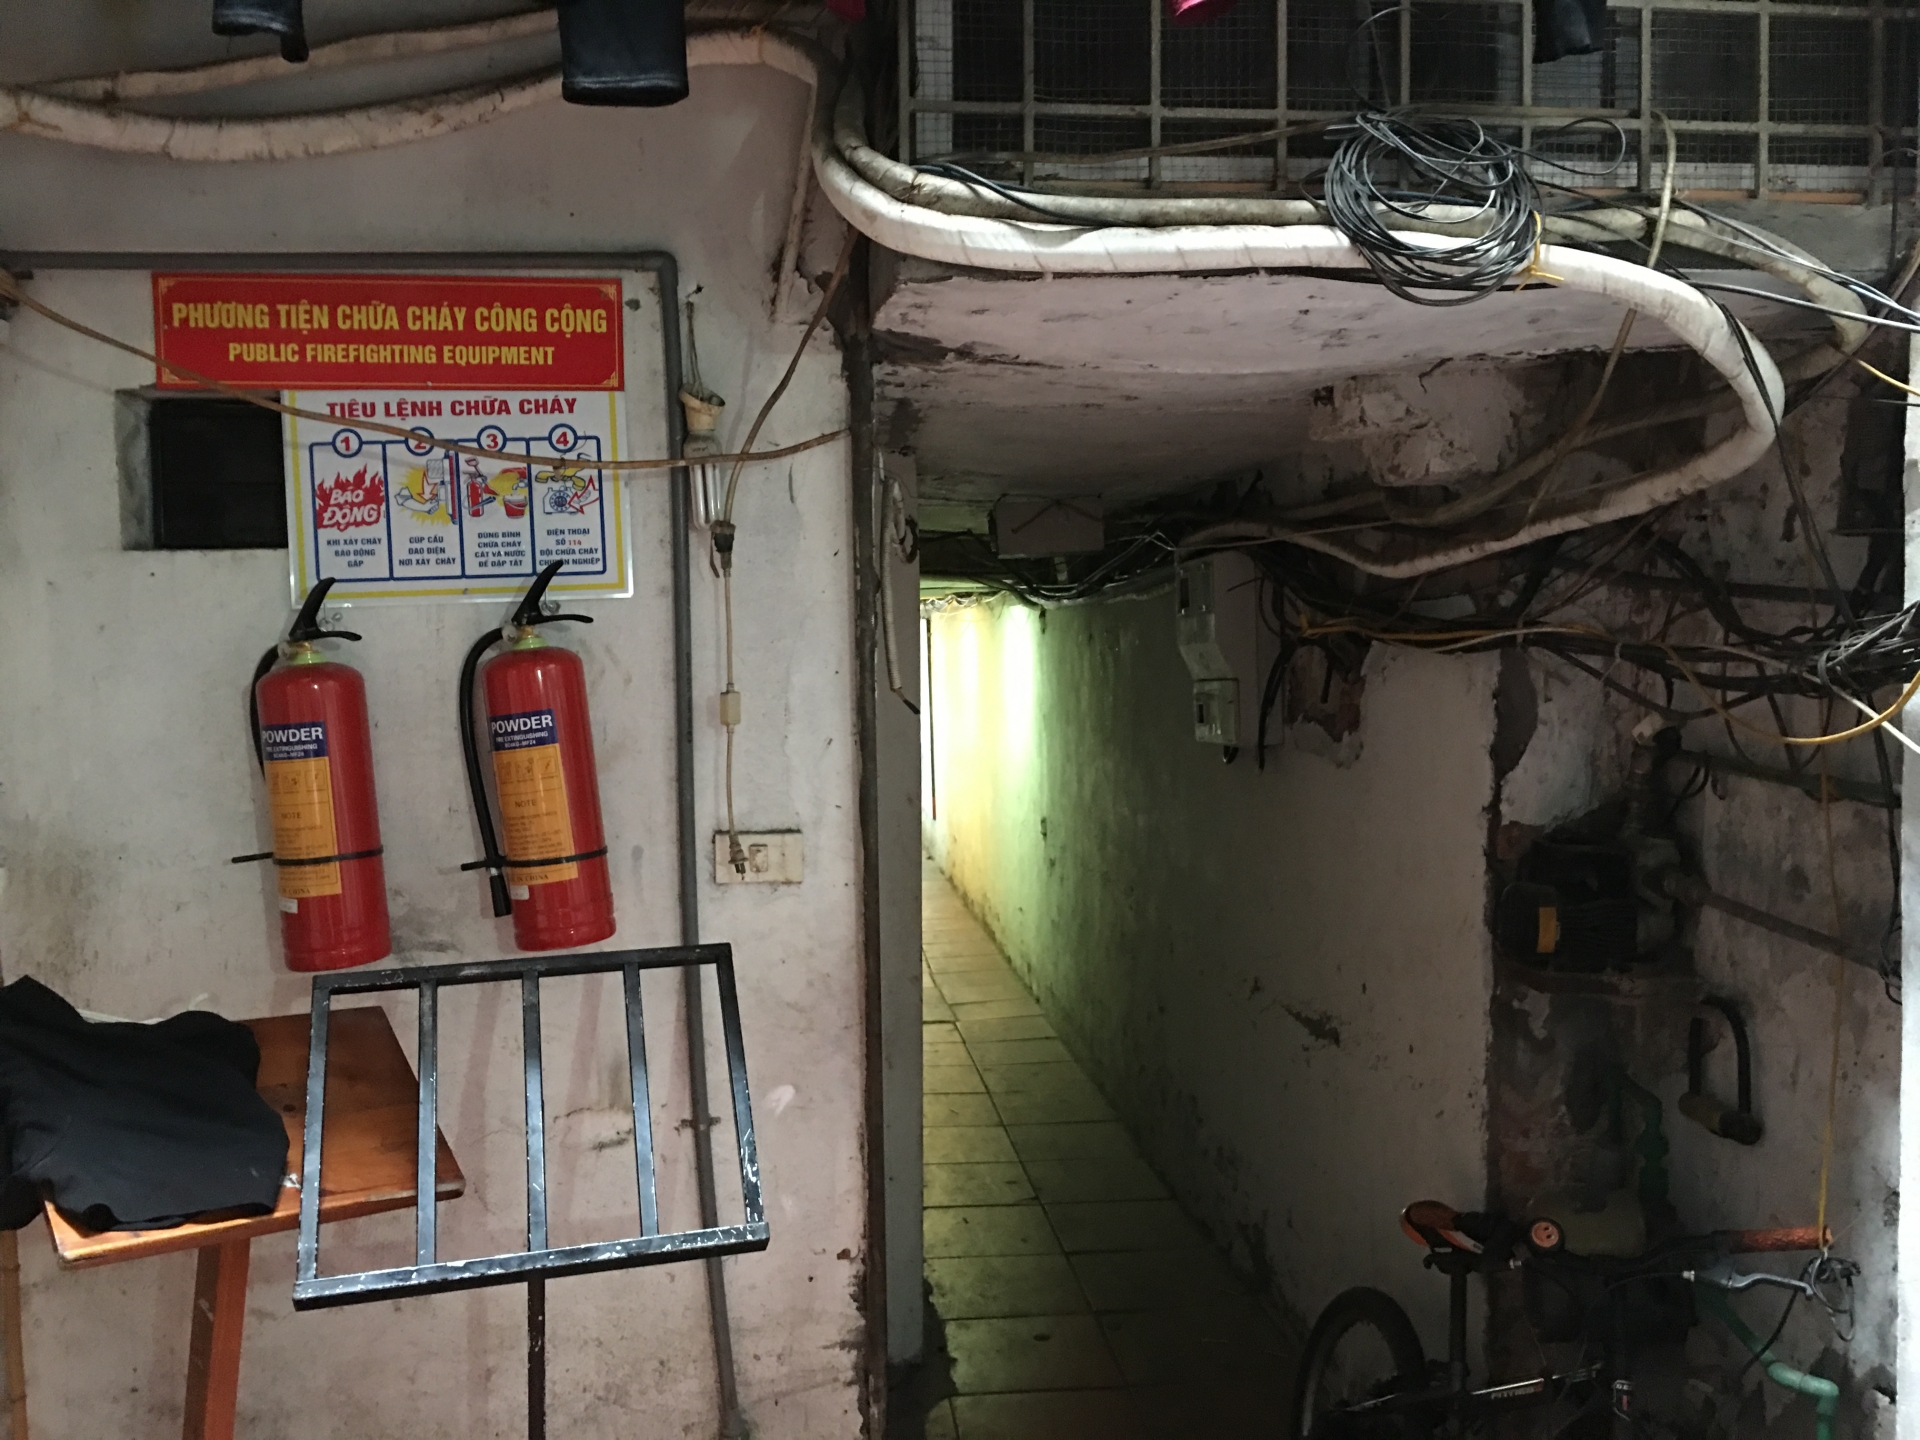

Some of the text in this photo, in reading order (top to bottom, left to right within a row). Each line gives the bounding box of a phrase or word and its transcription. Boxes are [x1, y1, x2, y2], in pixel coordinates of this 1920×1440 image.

[172, 300, 607, 338] PHƯƠNG TIỆN CHỮA CHÁY CÔNG CỘNG
[229, 343, 555, 366] PUBLIC FIREFIGHTING EQUIPMENT
[326, 395, 577, 420] TIÊU LỆNH CHỮA CHÁY
[341, 436, 350, 452] 1
[486, 433, 499, 449] 3
[556, 431, 569, 447] 4
[330, 486, 364, 504] BÁO
[323, 504, 378, 529] ĐỘNG
[491, 714, 553, 735] POWDER
[514, 799, 538, 808] NOTE
